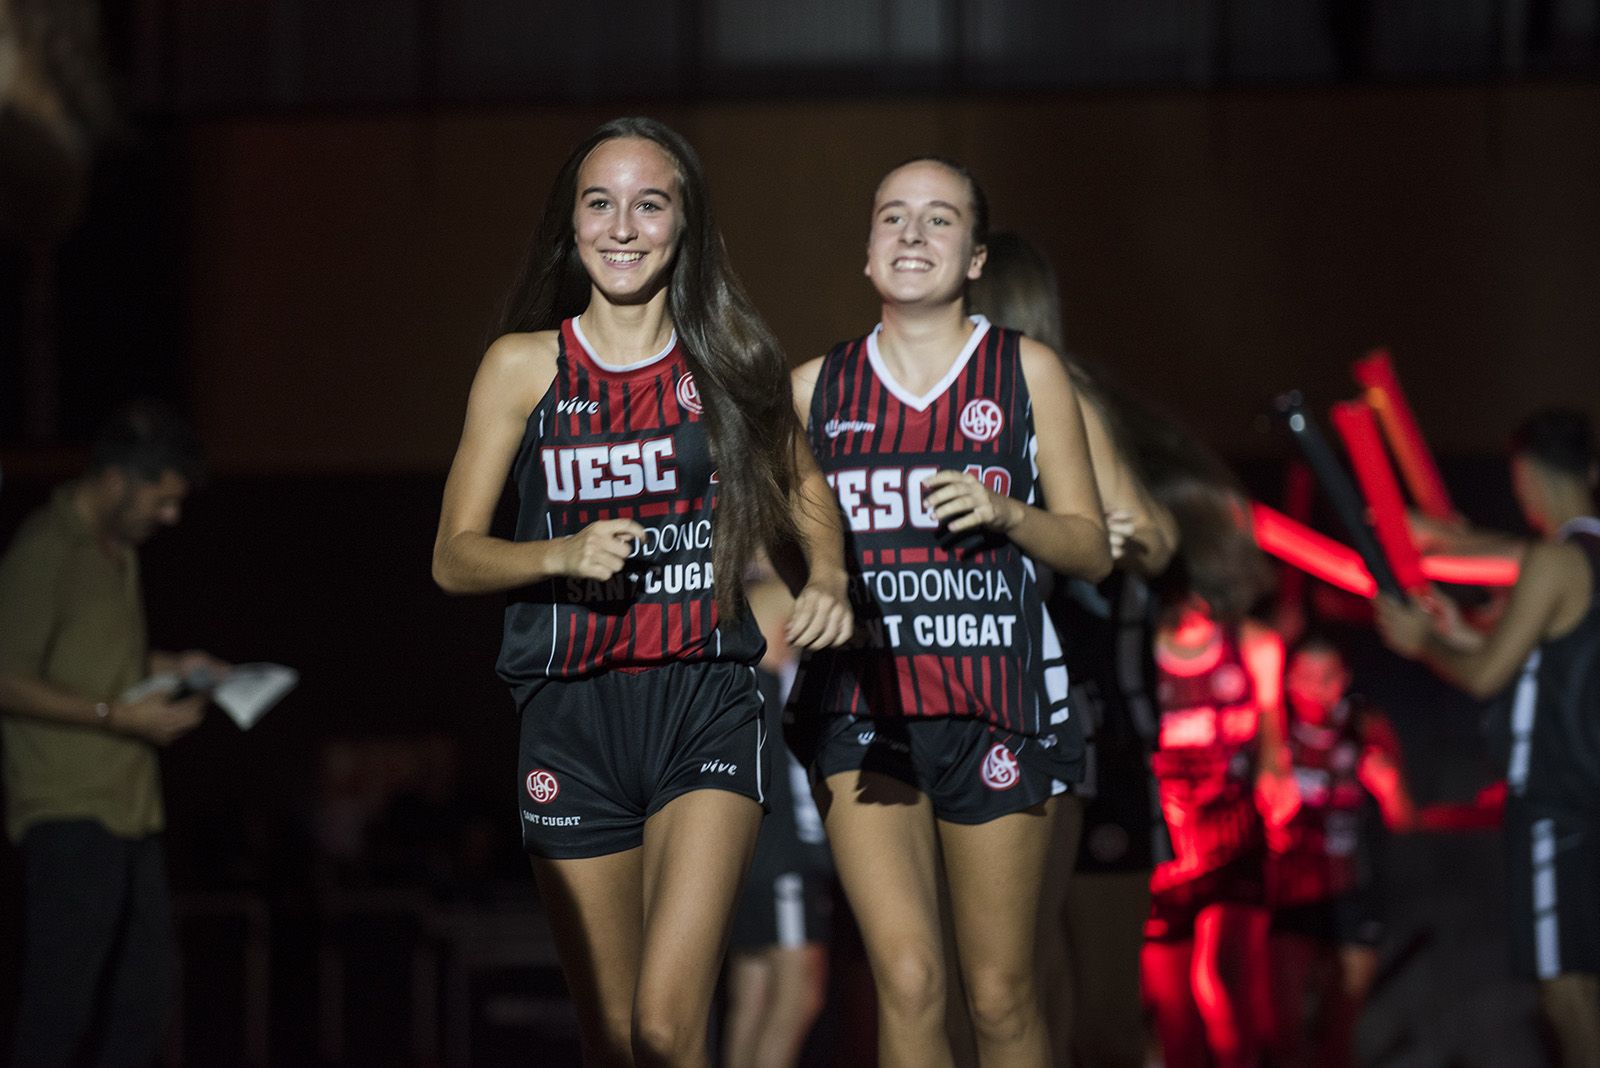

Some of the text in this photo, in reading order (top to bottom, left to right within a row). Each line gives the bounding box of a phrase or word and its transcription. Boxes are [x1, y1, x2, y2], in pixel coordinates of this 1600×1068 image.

[541, 435, 677, 502] UESC
[826, 465, 941, 532] ESC
[913, 613, 1017, 648] CUGAT
[541, 816, 581, 827] CUGAT
